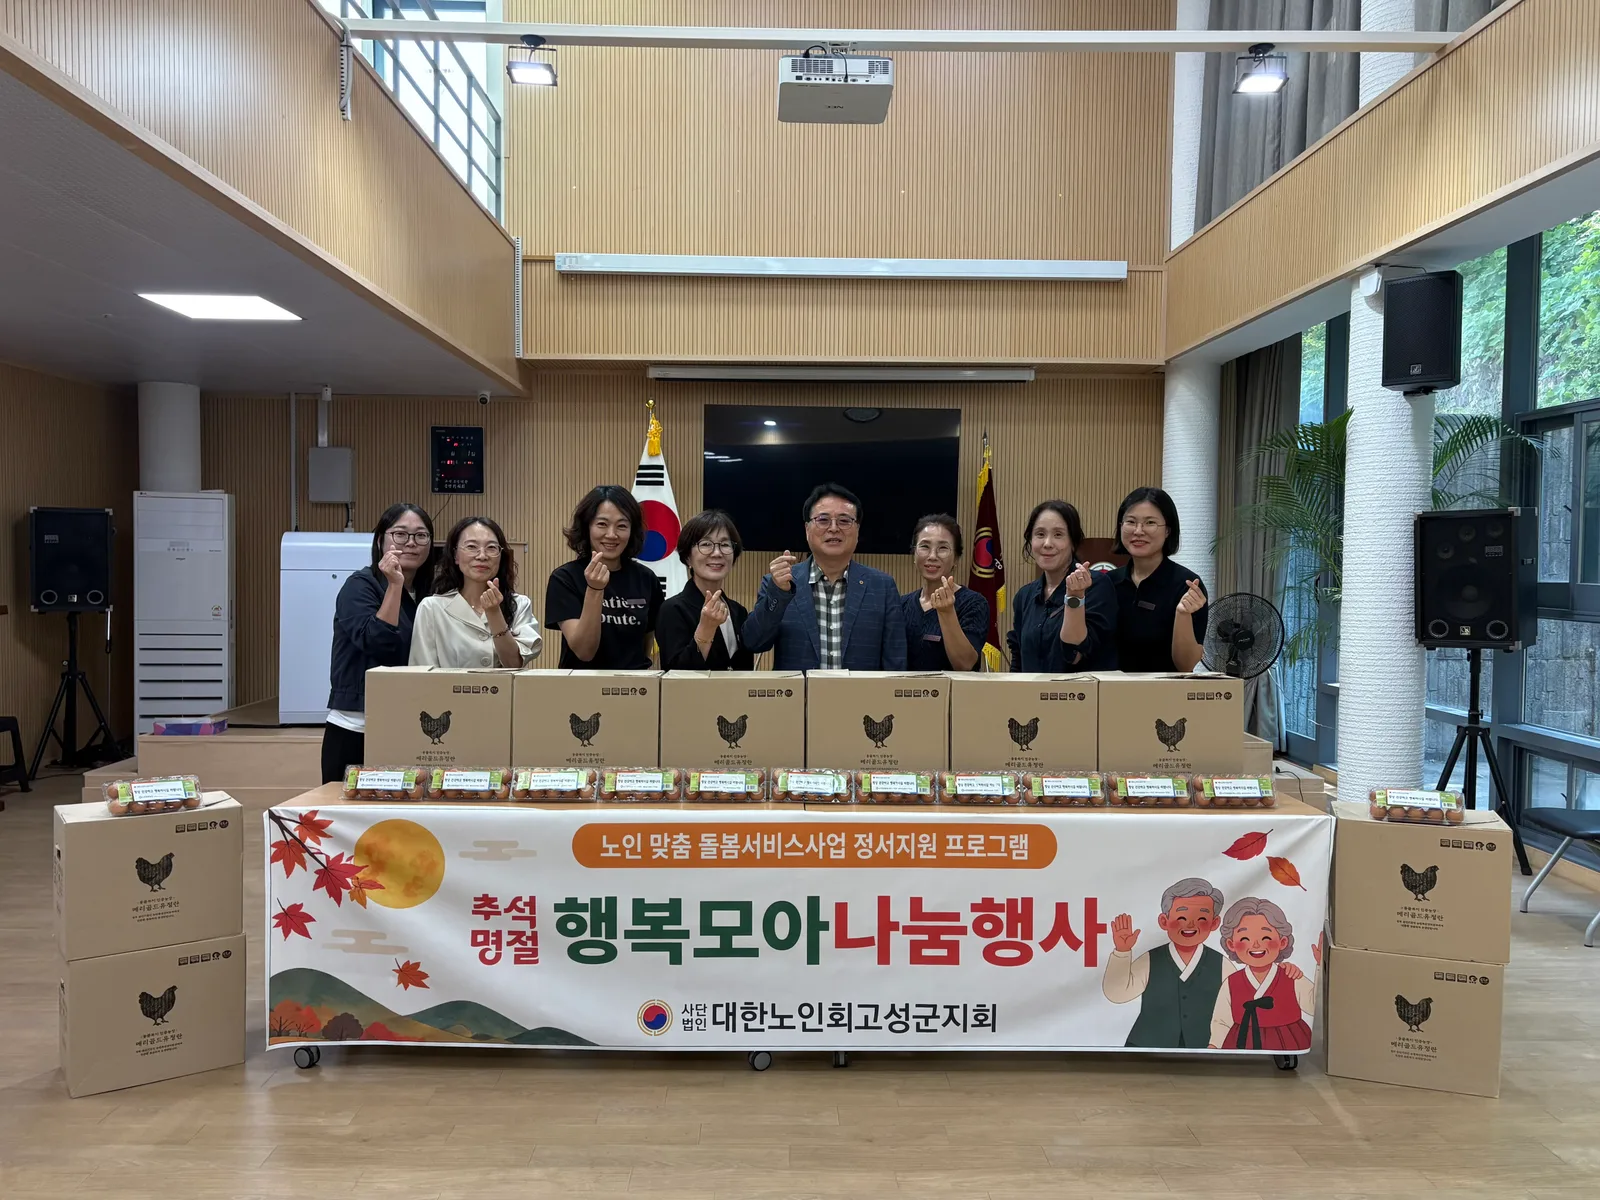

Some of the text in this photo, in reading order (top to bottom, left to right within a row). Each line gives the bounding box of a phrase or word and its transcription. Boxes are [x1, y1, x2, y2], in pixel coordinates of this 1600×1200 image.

[600, 832, 1028, 860] 노인 맞춤 돌봄서비스사업 정서지원 프로그램
[471, 894, 537, 929] 추석
[470, 930, 540, 965] 명절
[681, 1003, 708, 1016] 사단
[682, 1018, 706, 1032] 법인
